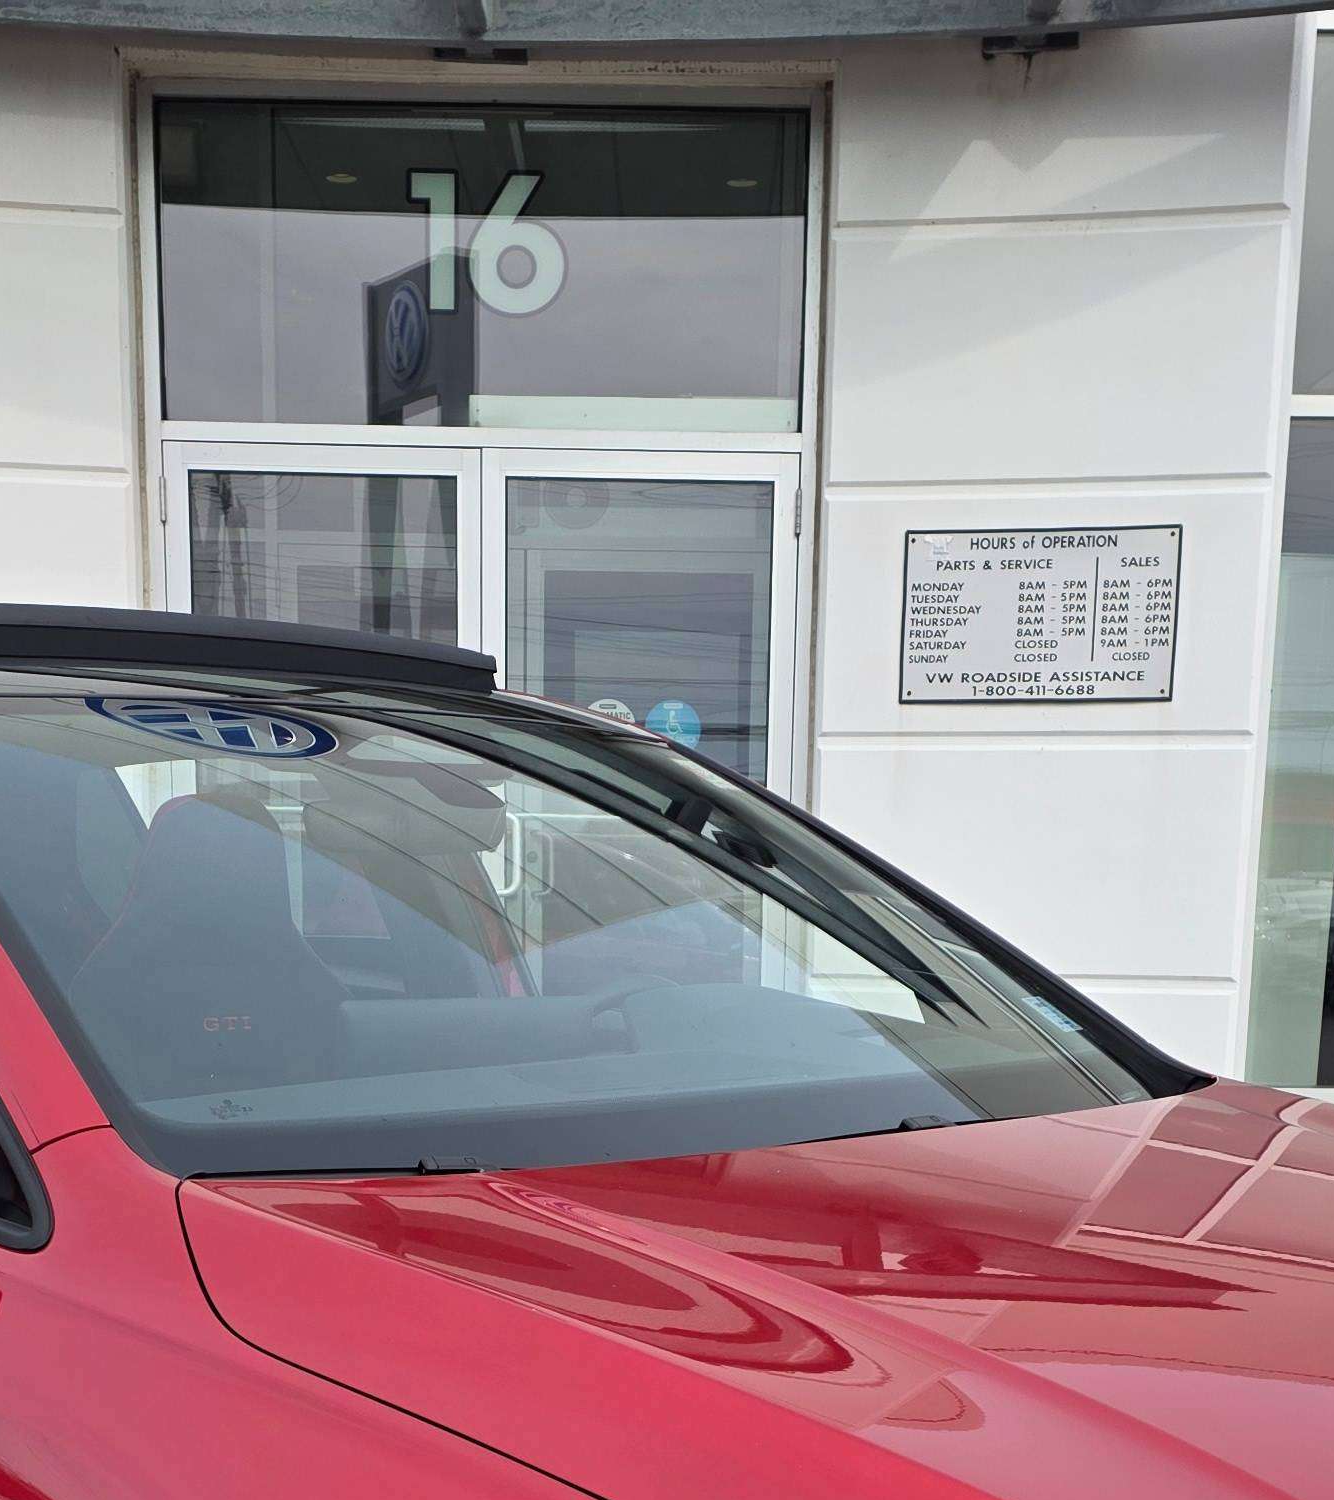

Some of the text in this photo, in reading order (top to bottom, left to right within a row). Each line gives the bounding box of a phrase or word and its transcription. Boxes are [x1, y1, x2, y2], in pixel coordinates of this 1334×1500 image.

[410, 171, 565, 314] 16
[970, 535, 1118, 550] HOURS of OPERATION
[936, 559, 1054, 571] PARTS & SERVICE
[1120, 556, 1160, 567] SALES
[911, 582, 965, 592] MONDAY
[1019, 581, 1046, 590] 8AM
[1063, 580, 1087, 589] 5PM
[1103, 579, 1131, 588] 8AM
[1147, 578, 1173, 588] 6PM
[911, 594, 960, 604] TUESDAY
[1018, 593, 1046, 602] 8AM
[1061, 592, 1087, 602] 5PM
[1102, 591, 1130, 600] 8AM
[1147, 590, 1172, 600] 6PM
[911, 605, 982, 615] WEDNESDAY
[1017, 604, 1045, 614] 8AM
[1062, 604, 1087, 613] 5PM
[1101, 603, 1129, 612] 8AM
[1145, 602, 1171, 612] 6PM
[910, 617, 969, 627] THURSDAY
[1017, 616, 1044, 625] 8AM
[1061, 616, 1086, 625] 5PM
[1101, 614, 1128, 624] 8AM
[1145, 614, 1171, 624] 6PM
[909, 629, 948, 639] FRIDAY
[1016, 628, 1044, 637] 8AM
[1061, 627, 1086, 637] 5PM
[1100, 626, 1128, 636] 8AM
[1144, 625, 1170, 635] 6PM
[909, 640, 1059, 651] SATURDAY CLOSED
[1100, 639, 1127, 648] 9AM
[1144, 638, 1169, 648] 1PM
[908, 653, 1058, 664] SUNDAY CLOSED
[1111, 651, 1151, 661] CLOSED
[926, 670, 1146, 684] VW ROADSIDE ASSISTANCE
[972, 684, 1096, 697] 1-800-411-6688
[203, 1016, 252, 1032] GTI
